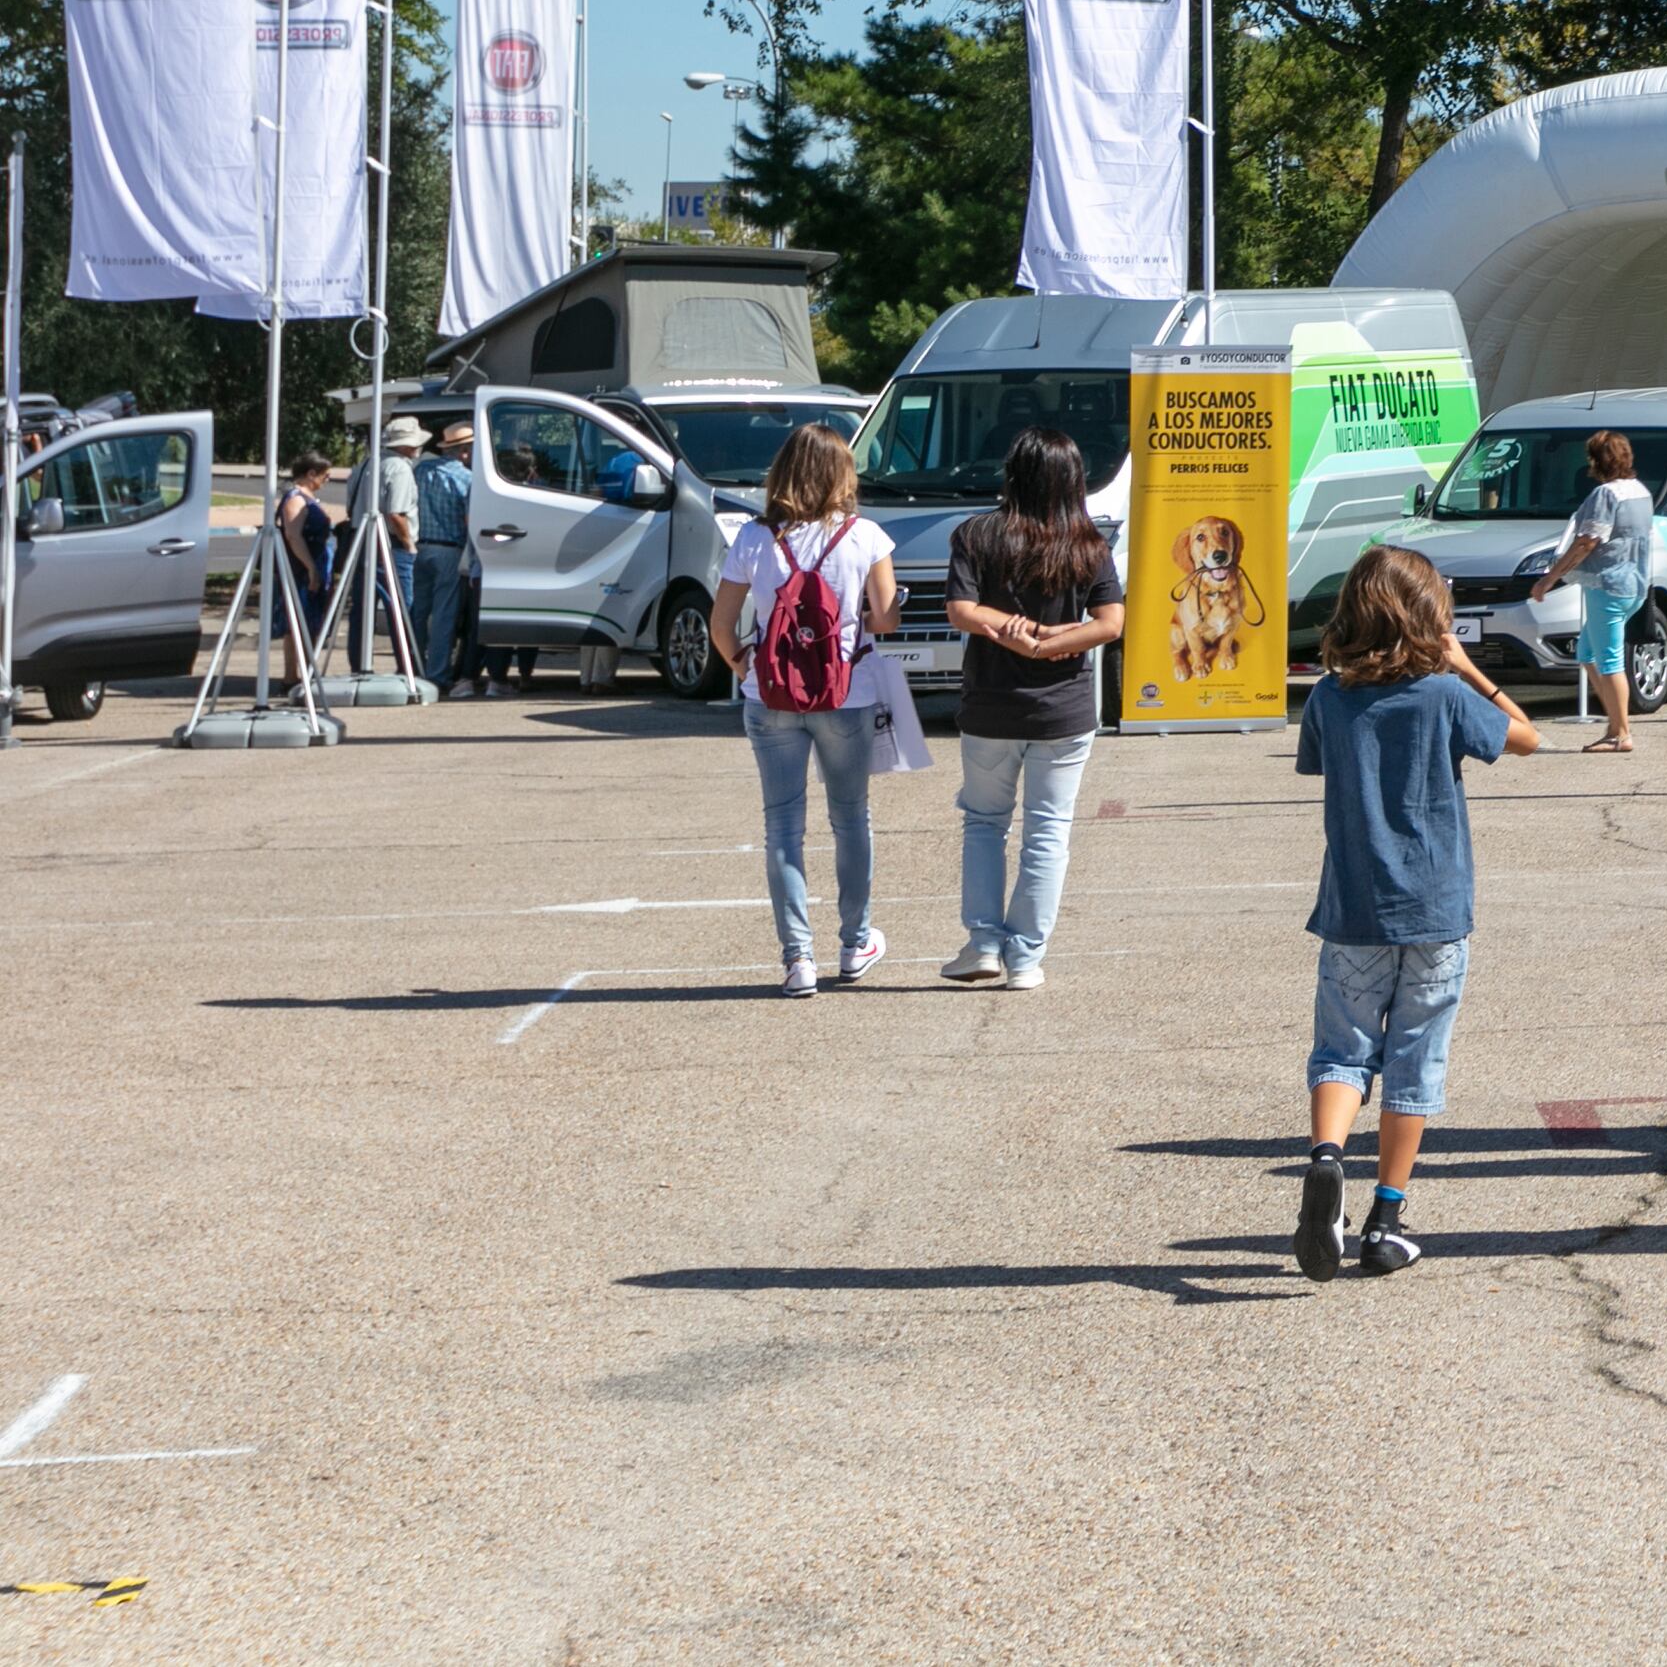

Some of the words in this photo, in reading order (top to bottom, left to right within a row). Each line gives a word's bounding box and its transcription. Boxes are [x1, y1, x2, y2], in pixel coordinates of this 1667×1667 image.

[1200, 353, 1287, 364] #YOSOYCONDUCTOR
[1166, 391, 1257, 409] BUSCAMOS
[1329, 374, 1368, 423] FIAT
[1373, 370, 1439, 420] DUCATO
[1148, 412, 1159, 429] A
[1165, 412, 1194, 430] LOS
[1200, 412, 1273, 430] MEJORES
[1148, 432, 1272, 450] CONDUCTORES.
[1335, 426, 1362, 453] NUEVA
[1365, 424, 1390, 451] GAMA
[1488, 438, 1517, 458] 5
[1170, 463, 1210, 474] PERROS
[1213, 463, 1249, 474] FELICES
